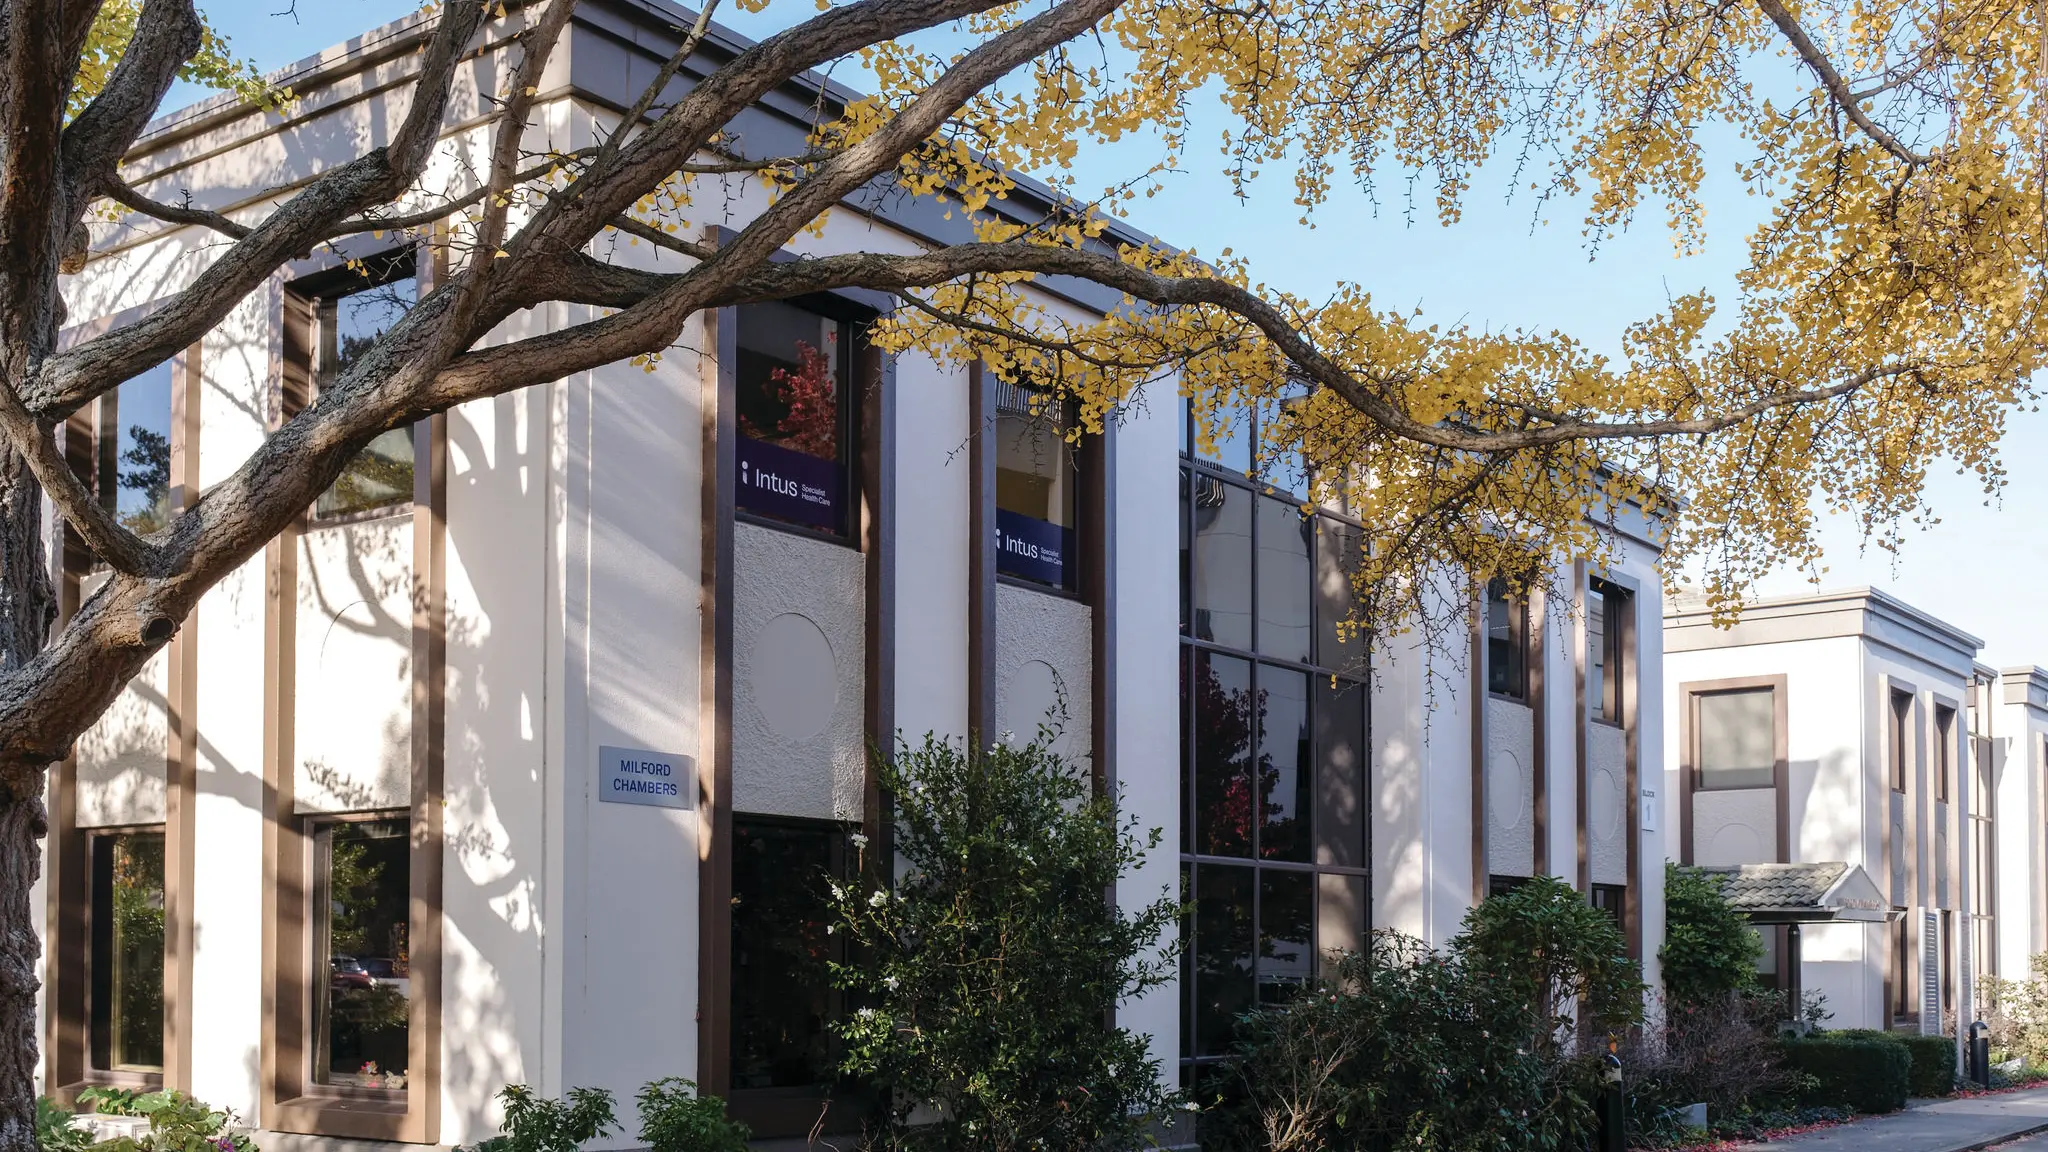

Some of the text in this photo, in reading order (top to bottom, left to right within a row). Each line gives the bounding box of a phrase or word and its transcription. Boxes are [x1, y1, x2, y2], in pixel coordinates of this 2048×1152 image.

[756, 468, 797, 497] Intus
[801, 484, 826, 497] Specialist
[801, 493, 831, 507] Health Care
[1006, 534, 1038, 559] Intus
[620, 760, 671, 776] MILFORD
[613, 778, 677, 796] CHAMBERS
